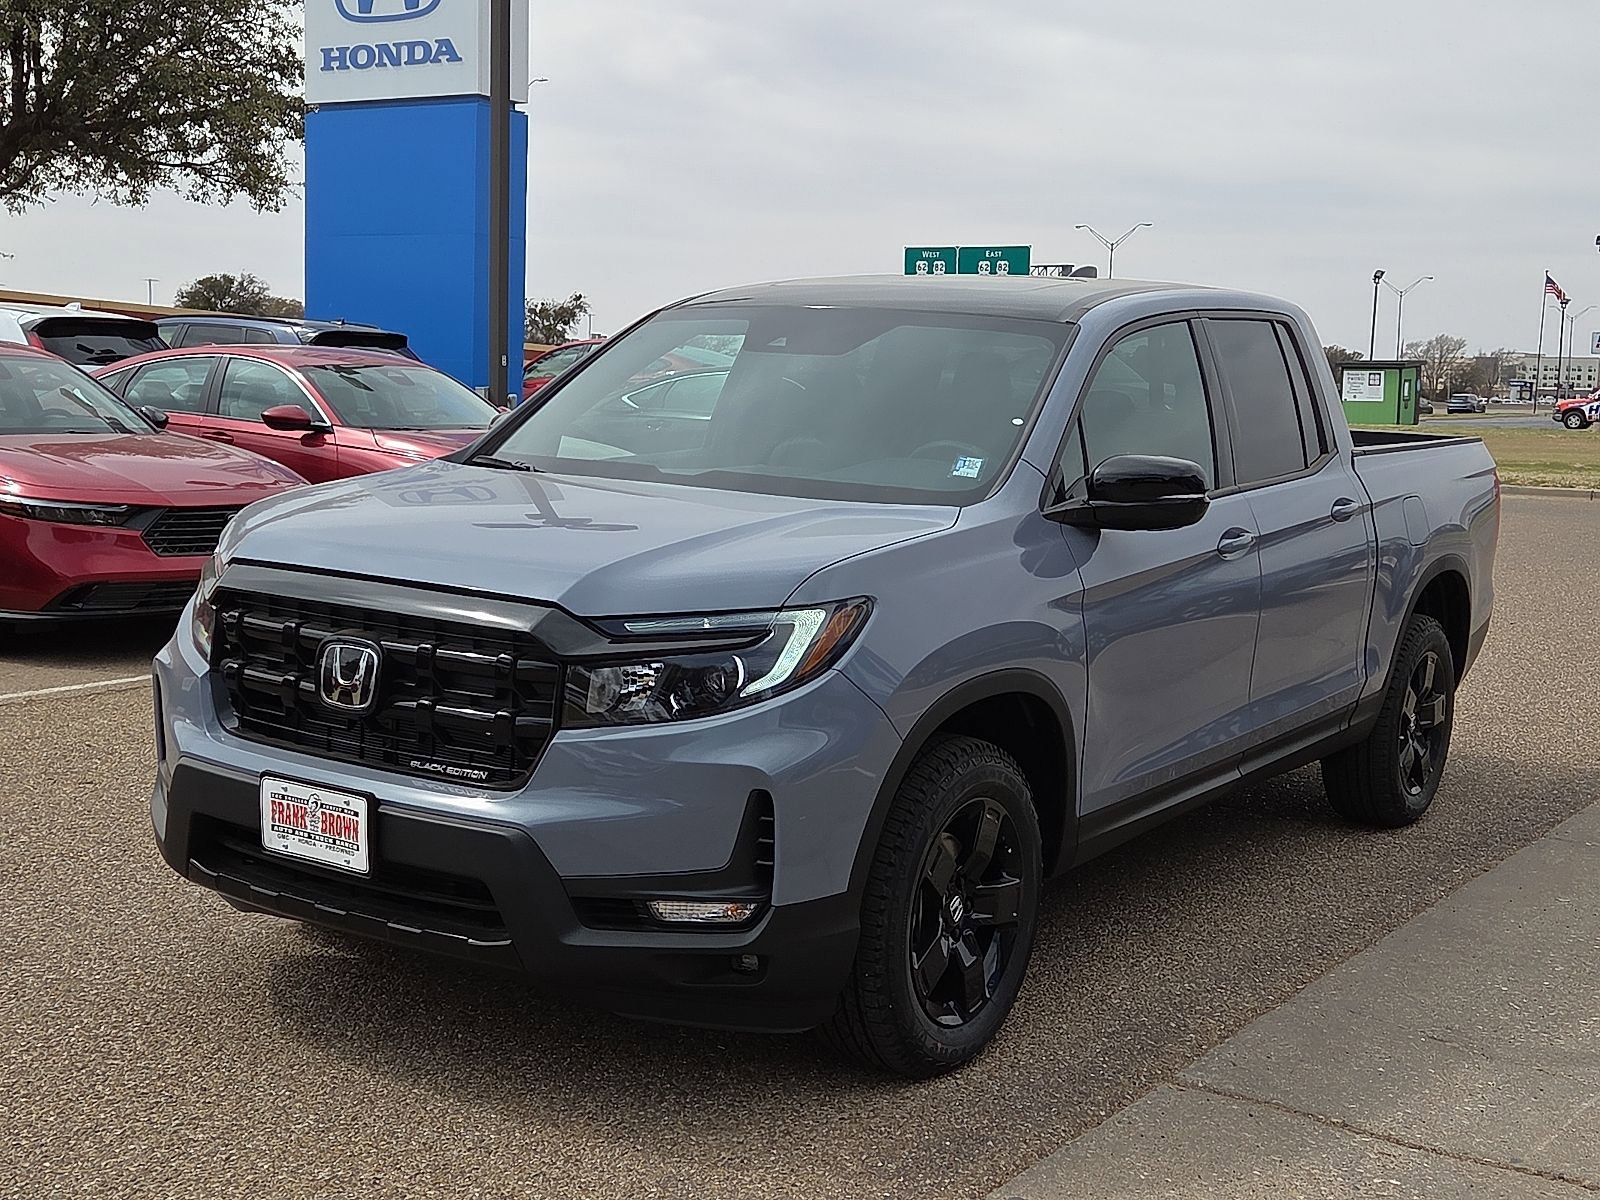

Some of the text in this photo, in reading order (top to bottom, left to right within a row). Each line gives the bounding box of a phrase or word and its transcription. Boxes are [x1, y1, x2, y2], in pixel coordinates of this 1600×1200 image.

[320, 38, 463, 71] HONDA
[922, 250, 940, 258] WEST
[985, 250, 1002, 258] EAST
[917, 263, 944, 271] 62 82
[979, 263, 1008, 271] 62 82
[410, 760, 488, 780] BLACK EDITION
[271, 800, 359, 843] FRANK BROWN
[273, 825, 358, 851] AUTO AND TRUCK RANCH
[277, 833, 290, 841] GMC
[298, 838, 317, 847] HONDA
